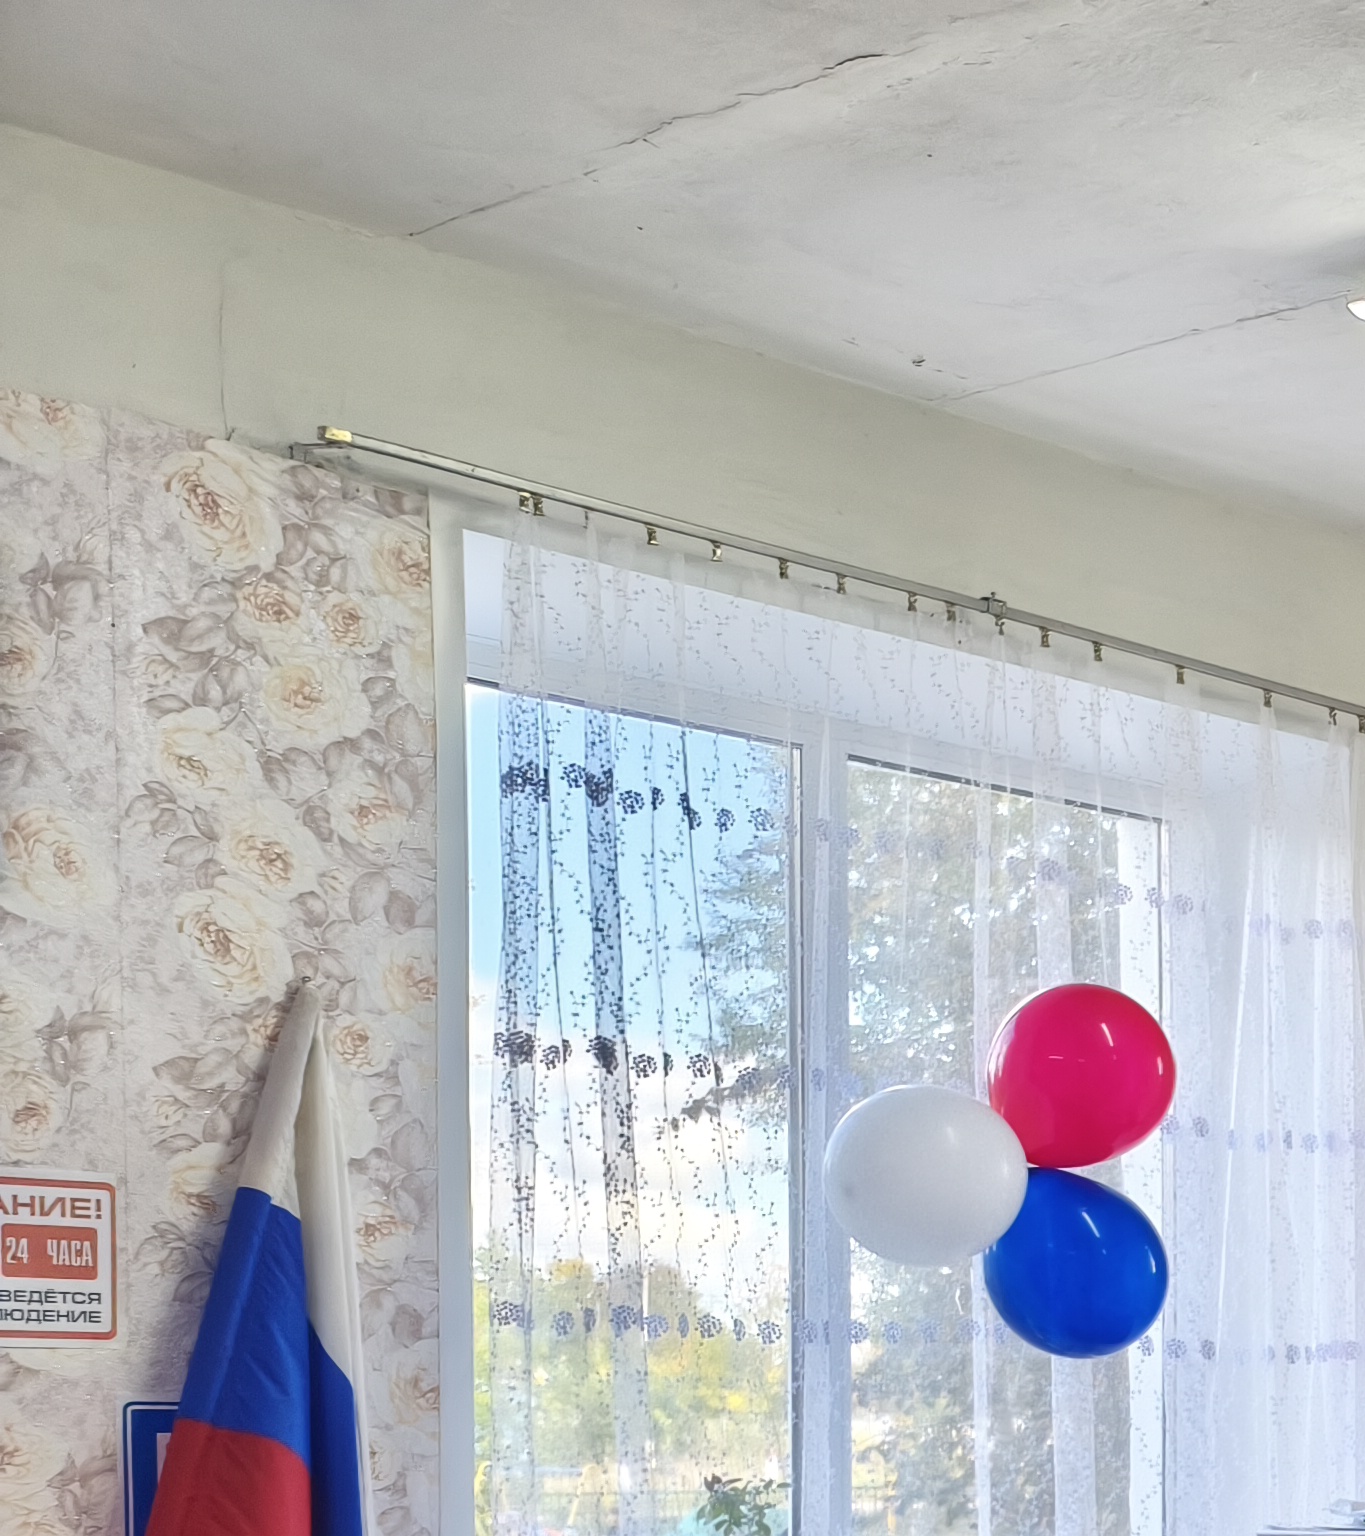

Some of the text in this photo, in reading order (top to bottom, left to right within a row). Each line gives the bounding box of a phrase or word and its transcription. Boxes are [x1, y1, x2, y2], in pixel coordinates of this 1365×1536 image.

[6, 1236, 94, 1267] 24 ЧАСА
[0, 1289, 102, 1306] ВЕДЁТСЯ
[0, 1308, 102, 1324] ЮДЕНИЕ
